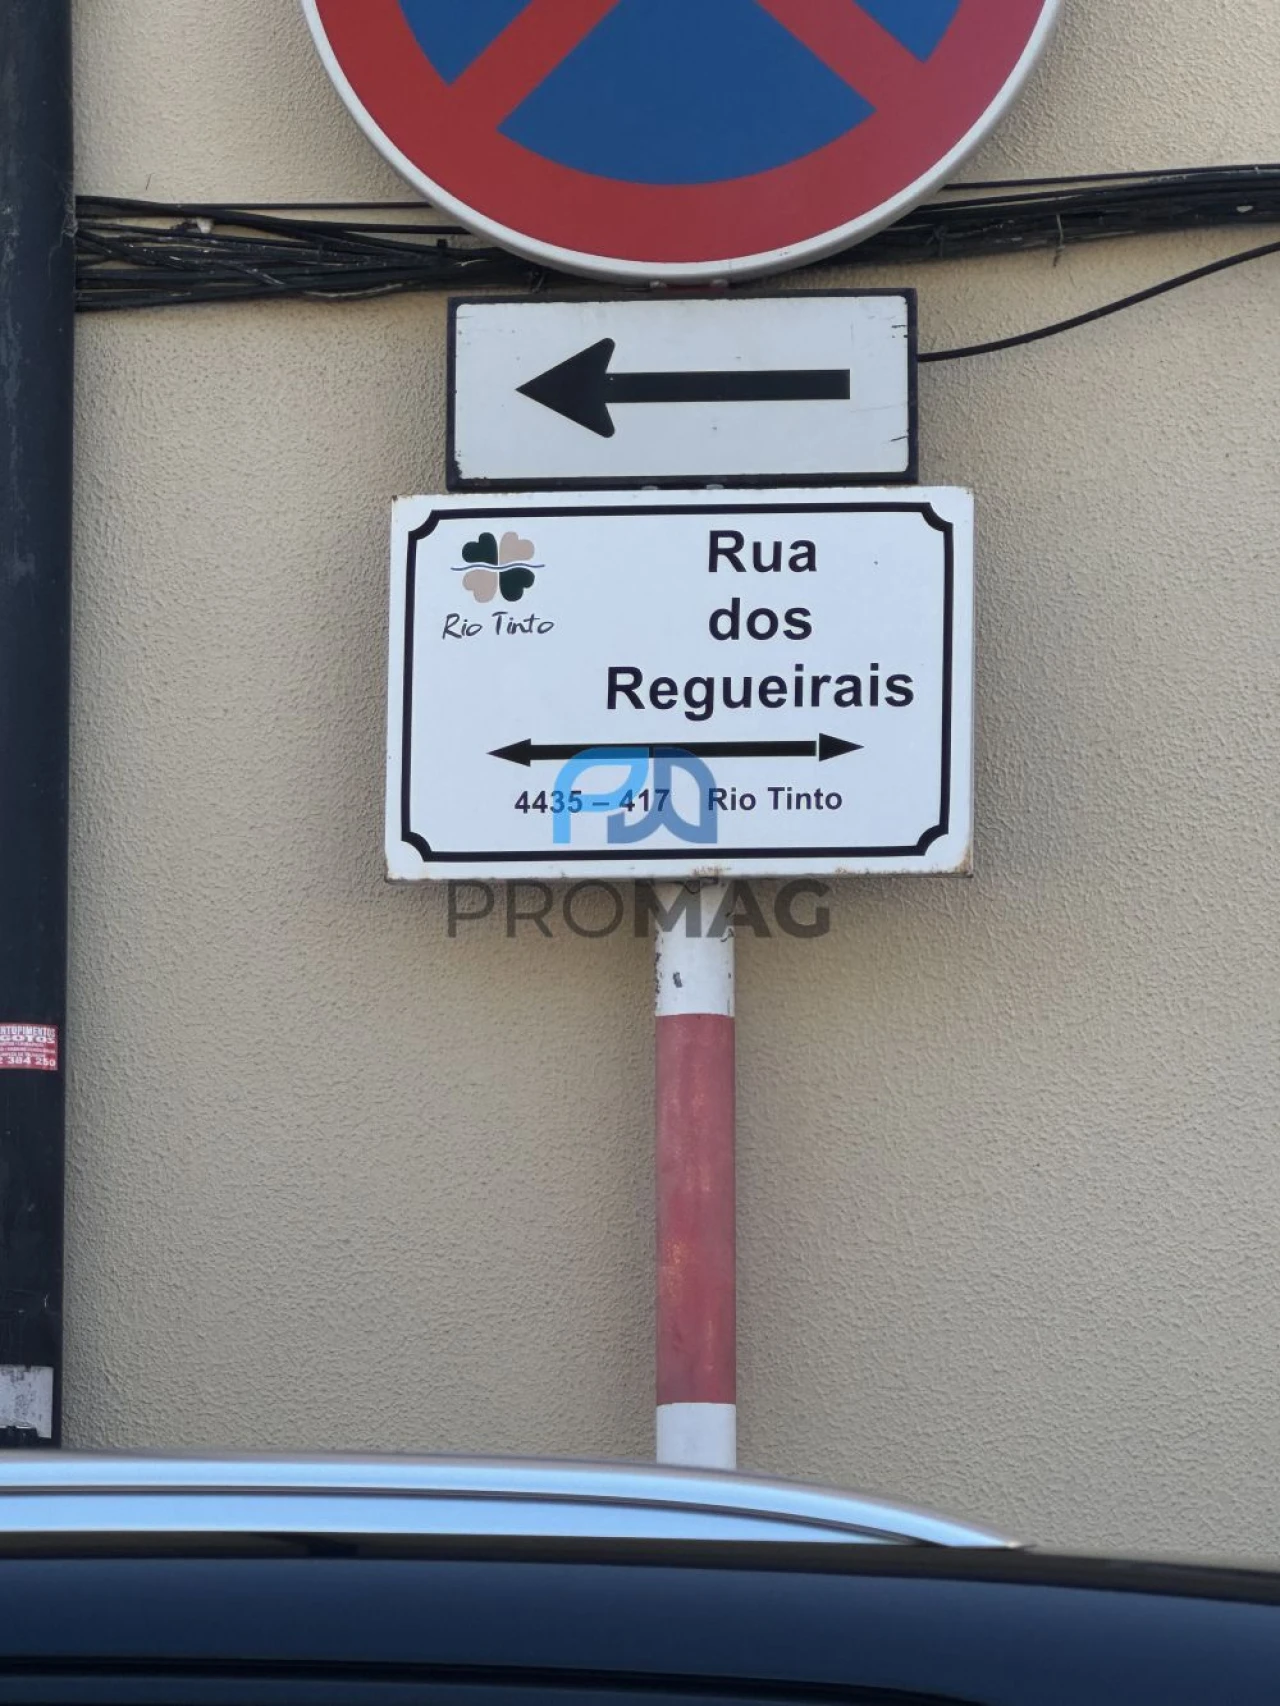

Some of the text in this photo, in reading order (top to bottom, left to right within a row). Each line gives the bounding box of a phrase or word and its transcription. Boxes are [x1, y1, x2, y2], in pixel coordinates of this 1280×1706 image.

[708, 530, 818, 573] Rua
[442, 611, 555, 640] Rio Tinto
[708, 597, 813, 641] dos
[607, 662, 915, 722] Regueirais
[514, 790, 583, 814] 4435
[619, 788, 671, 813] 417
[706, 787, 757, 812] Rio
[767, 786, 843, 811] Tinto
